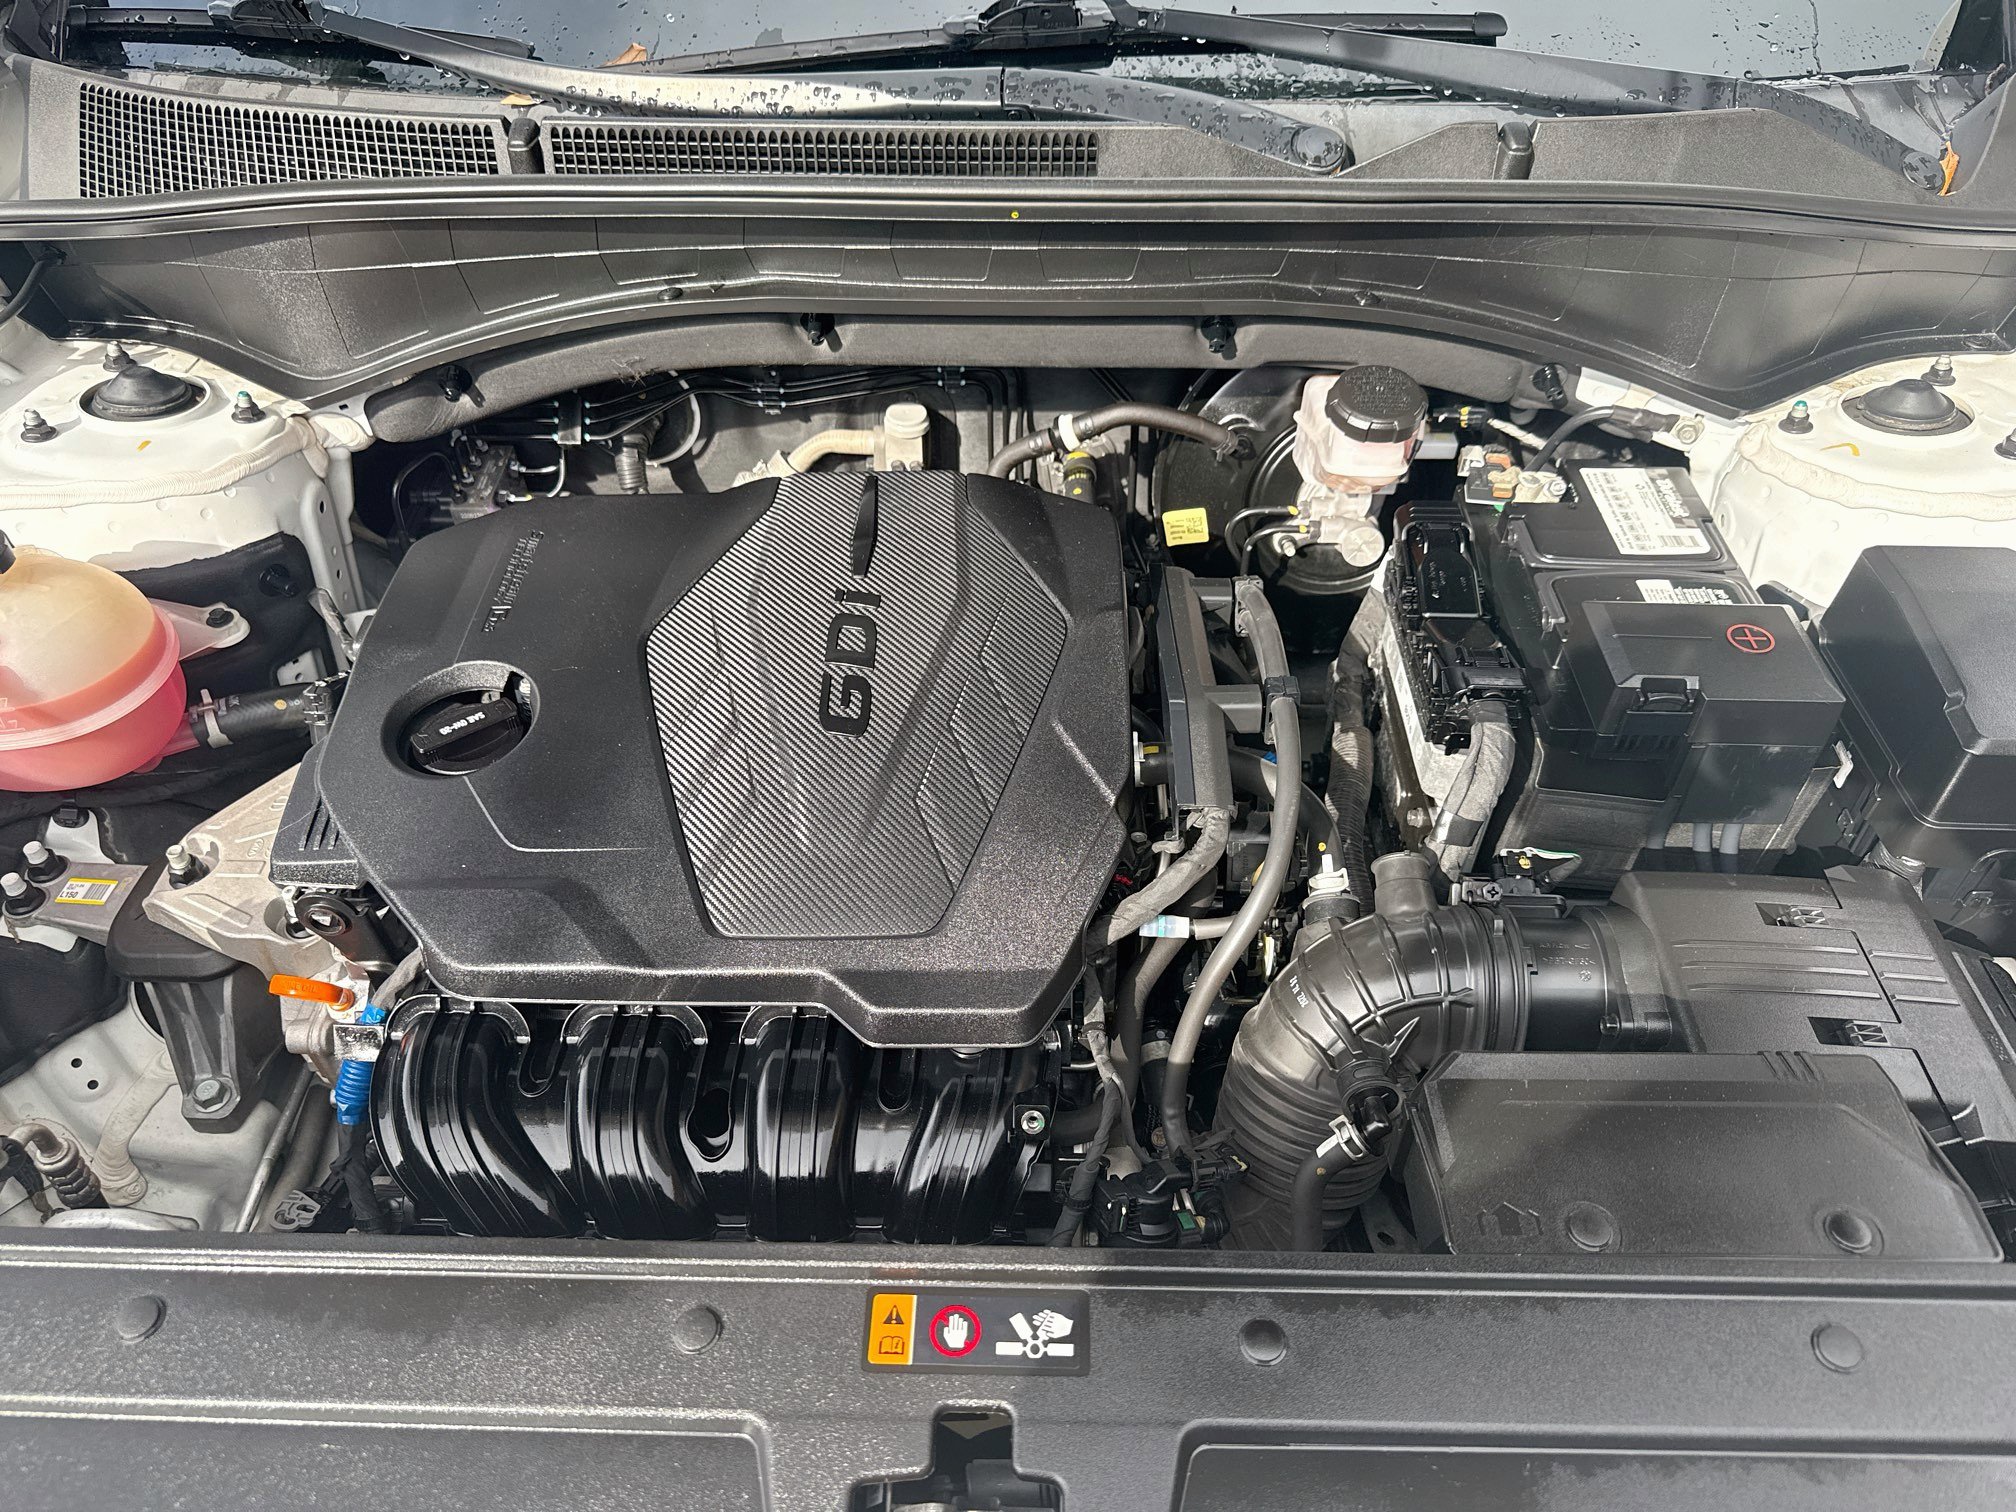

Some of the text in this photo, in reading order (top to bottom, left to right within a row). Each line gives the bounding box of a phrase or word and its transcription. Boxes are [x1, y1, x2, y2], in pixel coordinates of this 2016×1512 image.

[439, 711, 486, 736] SAE 0W-20
[60, 891, 79, 899] L150
